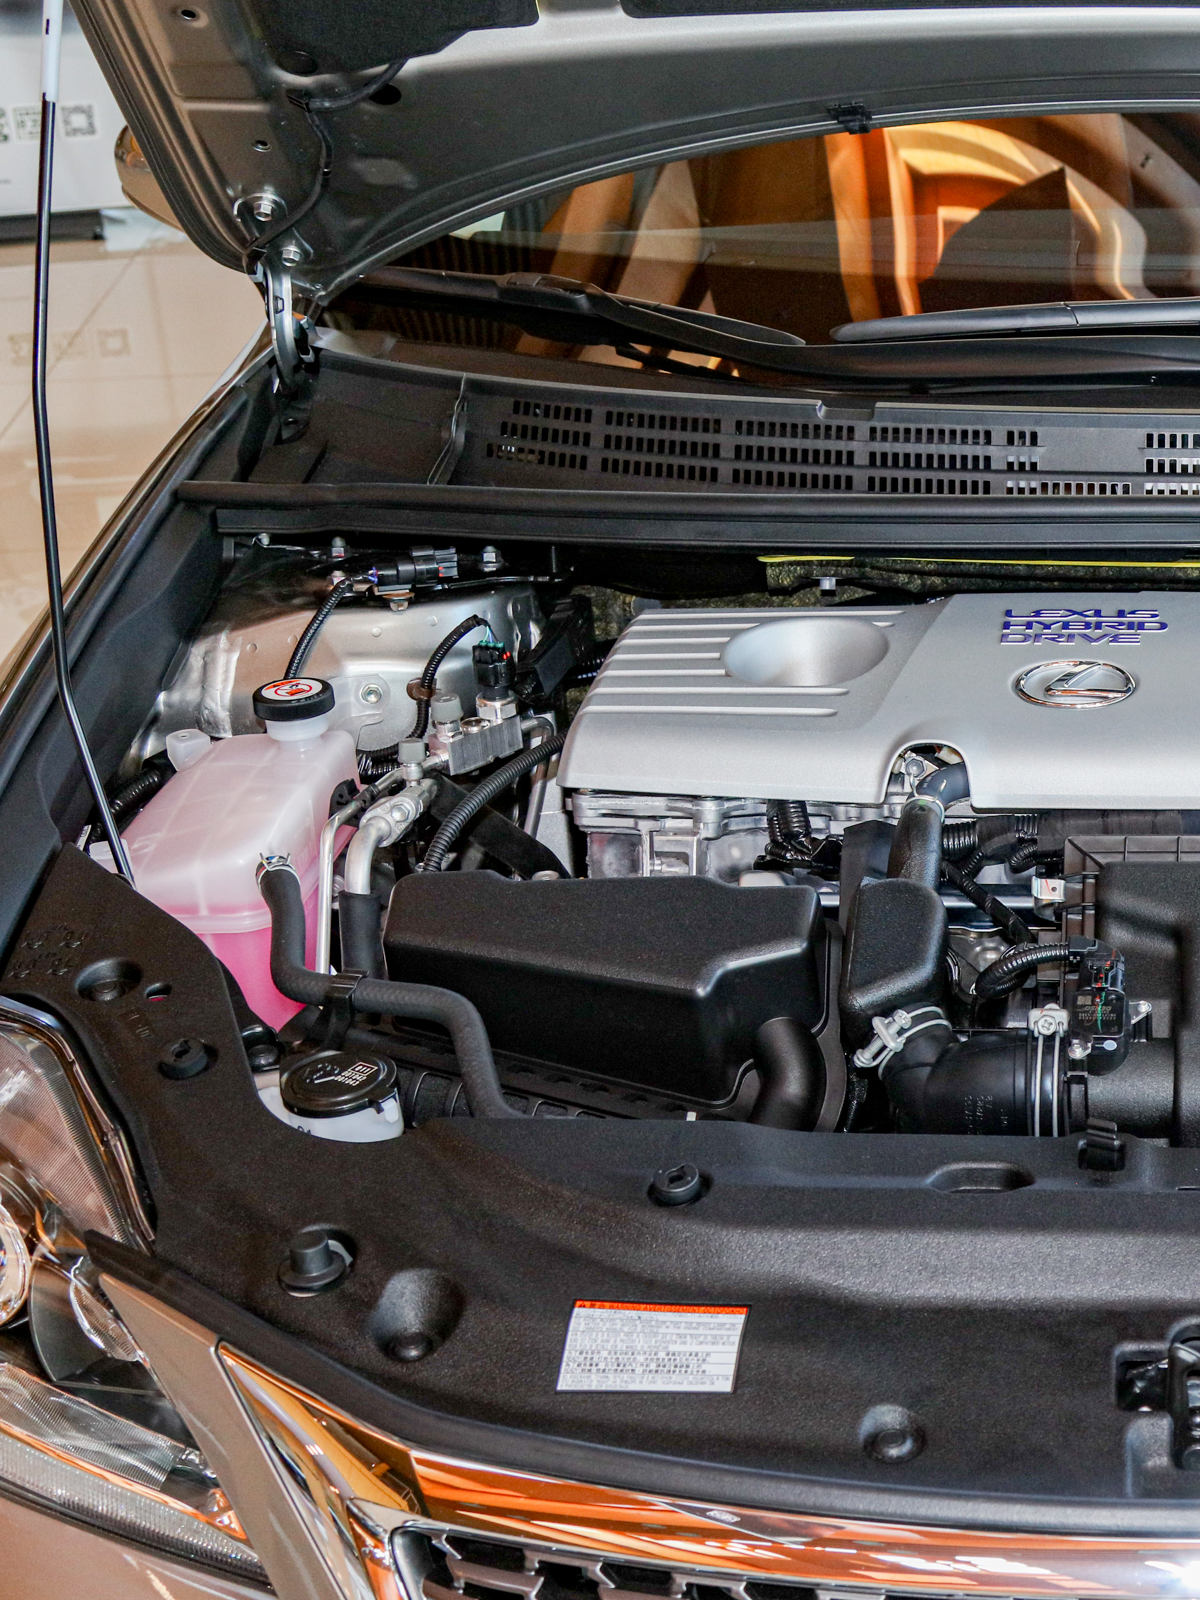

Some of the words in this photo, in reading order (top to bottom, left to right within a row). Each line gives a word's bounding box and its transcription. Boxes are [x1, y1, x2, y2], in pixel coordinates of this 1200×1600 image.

[1004, 609, 1160, 620] LEXUS
[1002, 621, 1168, 632] HYBRID
[1000, 633, 1142, 645] DRIVE
